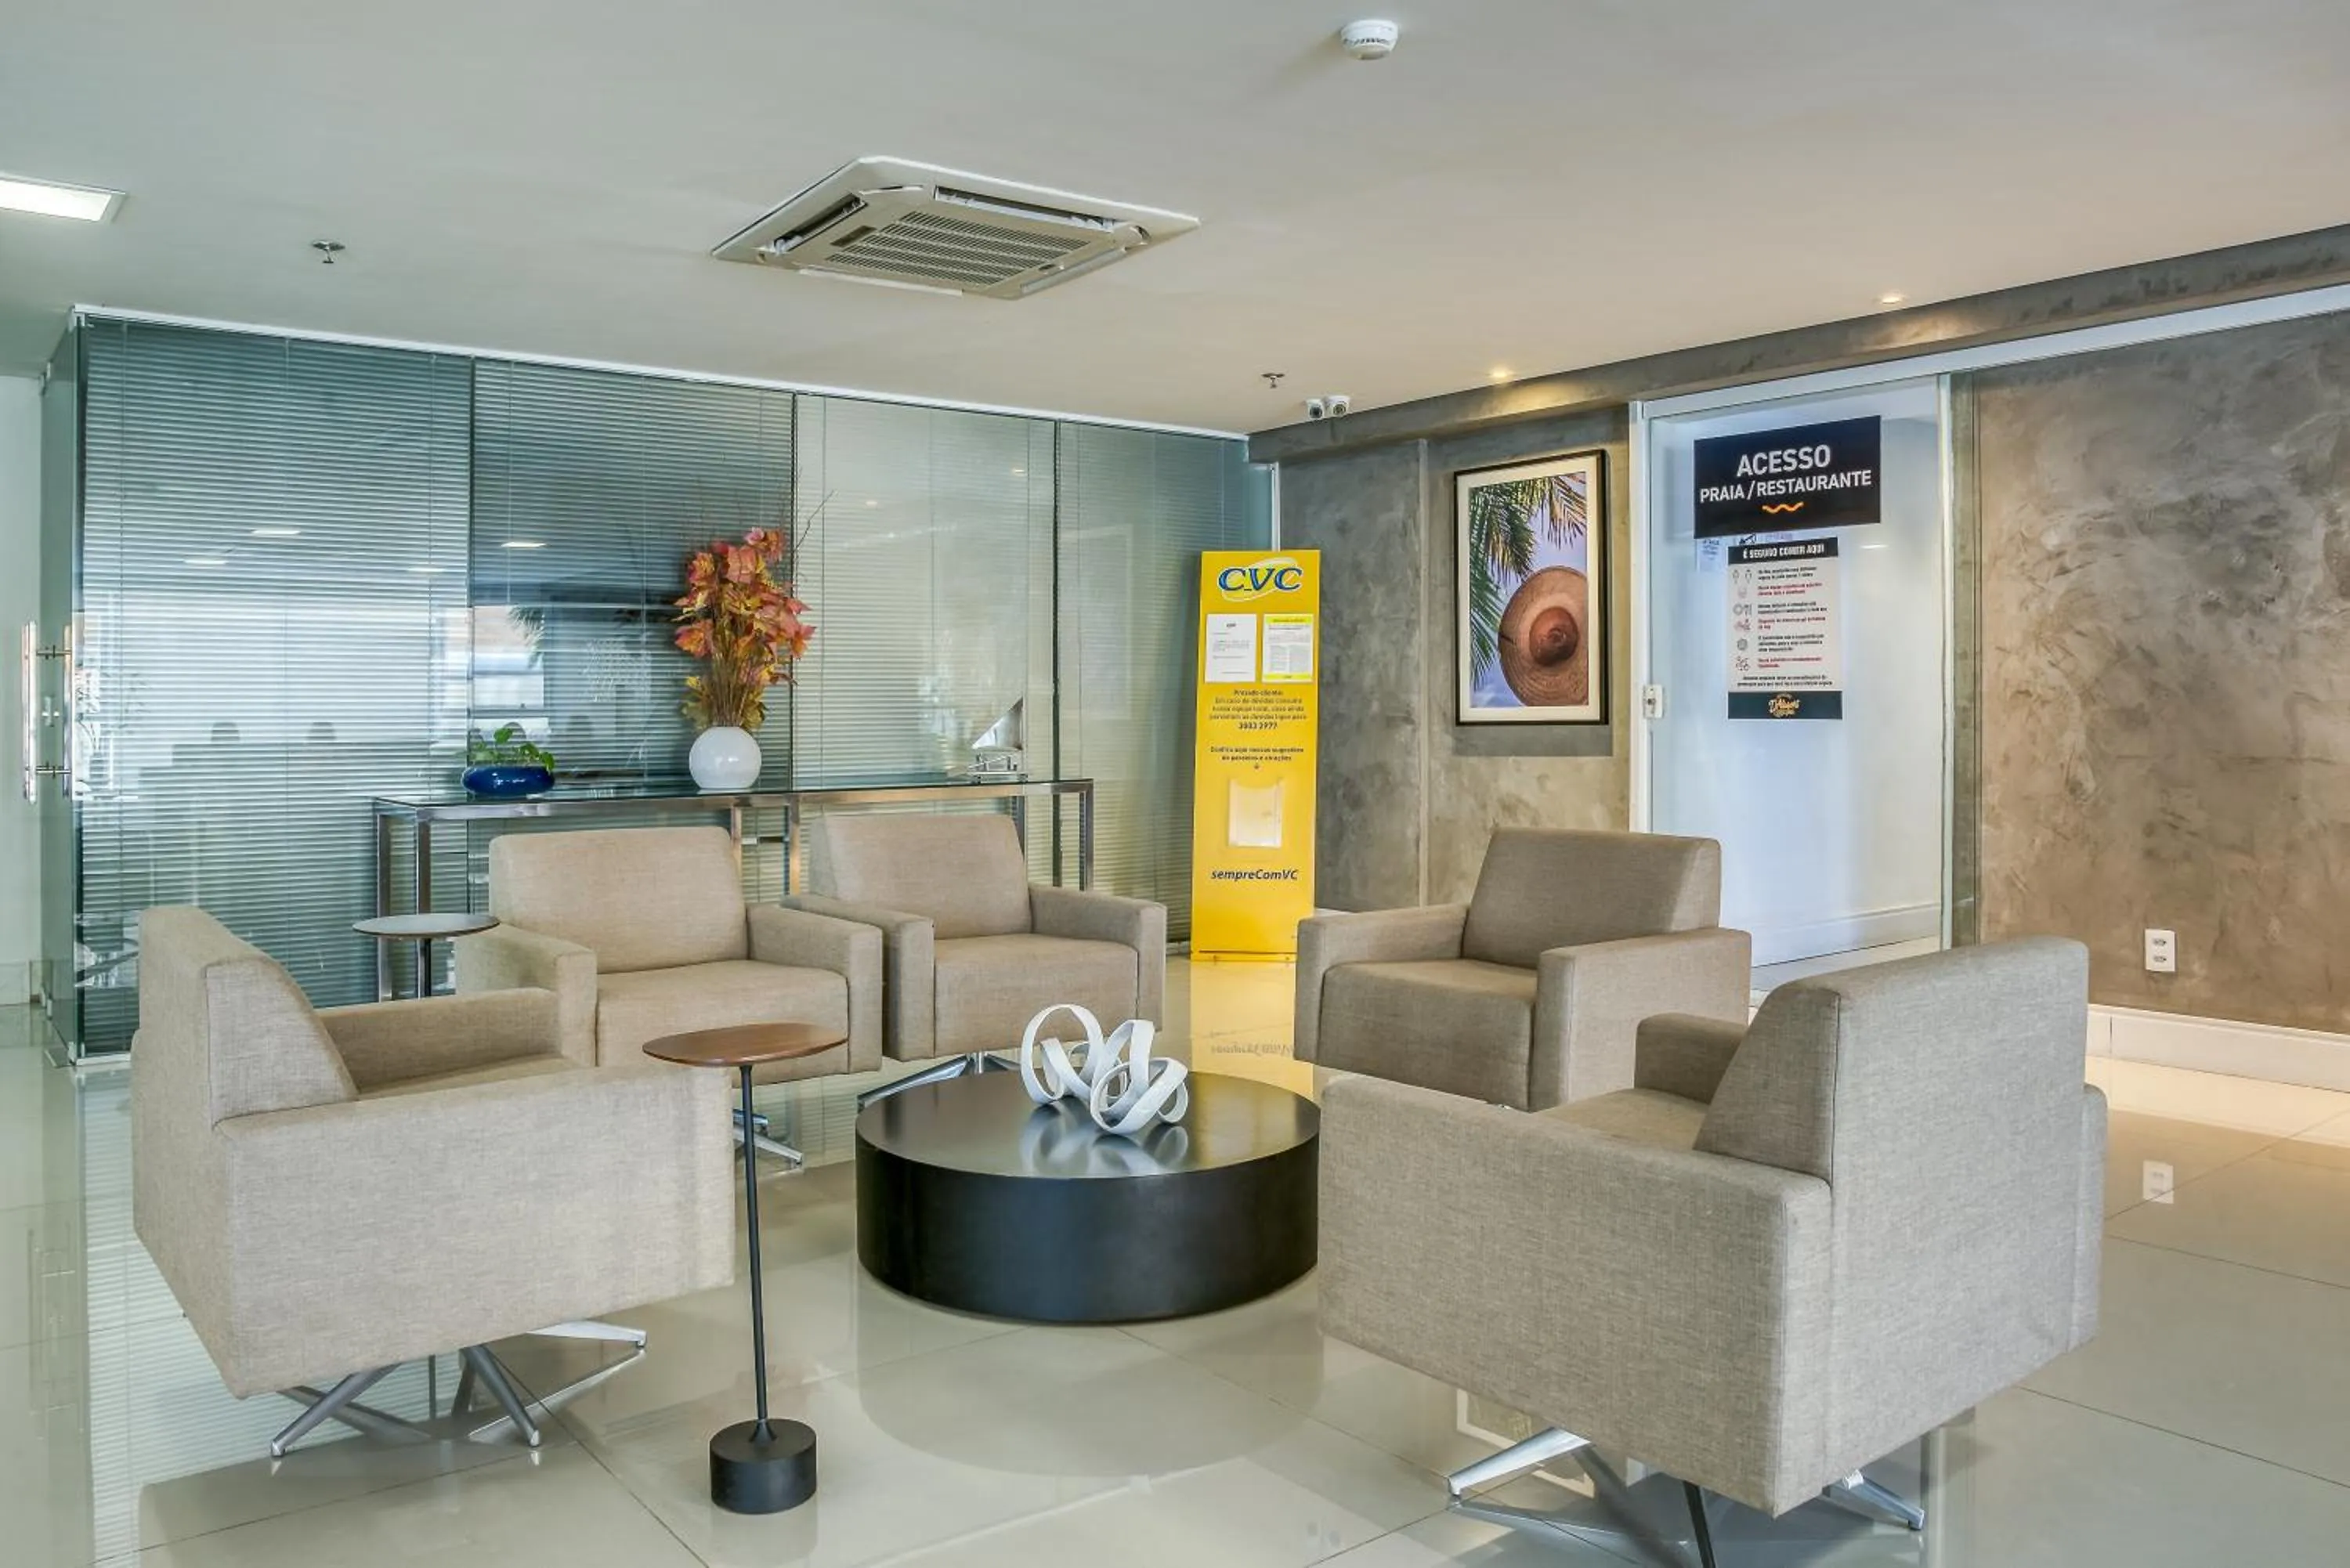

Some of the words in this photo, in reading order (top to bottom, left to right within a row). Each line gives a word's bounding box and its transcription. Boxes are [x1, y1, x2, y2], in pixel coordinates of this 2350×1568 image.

[1737, 444, 1831, 478] ACESSO
[1806, 544, 1824, 556] AQUI
[1219, 568, 1303, 591] CVC
[1211, 869, 1299, 882] sempreComVC
